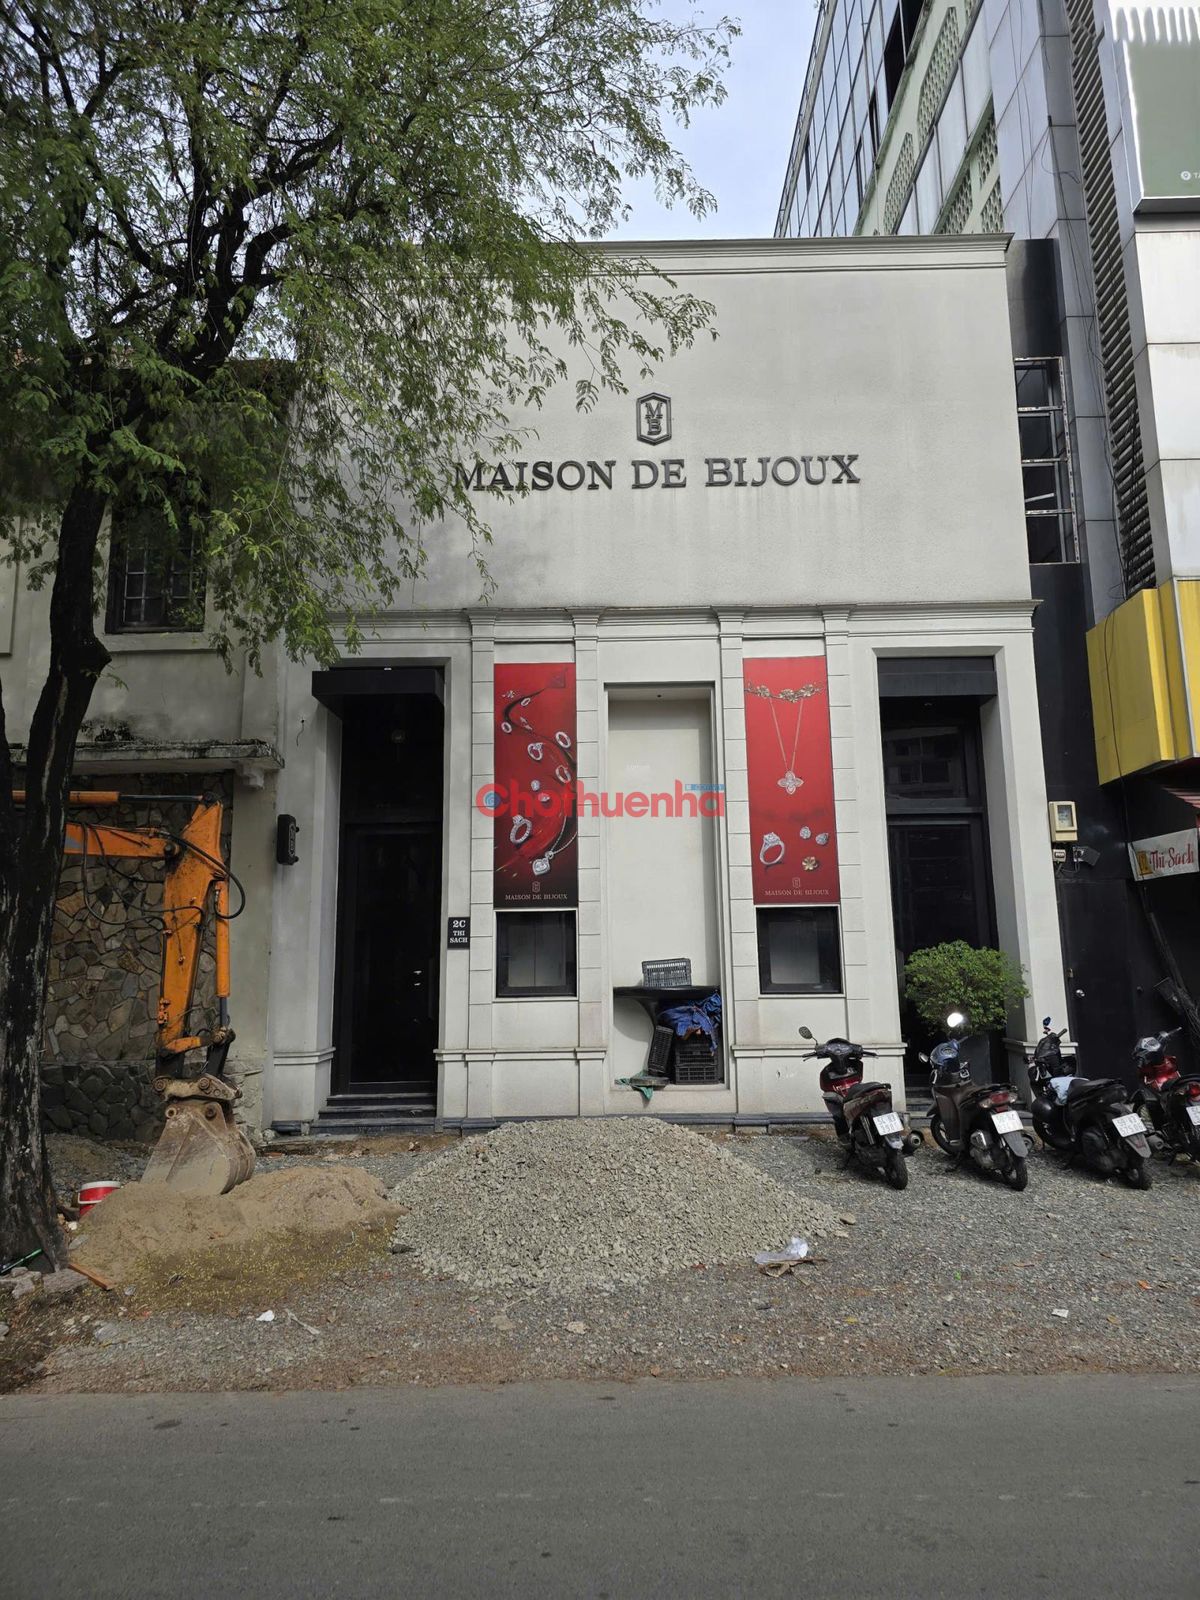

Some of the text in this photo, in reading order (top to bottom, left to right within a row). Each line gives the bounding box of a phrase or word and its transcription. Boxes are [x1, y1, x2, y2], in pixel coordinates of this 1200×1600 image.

[453, 454, 861, 491] MAISON DE BIJOUX
[453, 920, 466, 928] 2C
